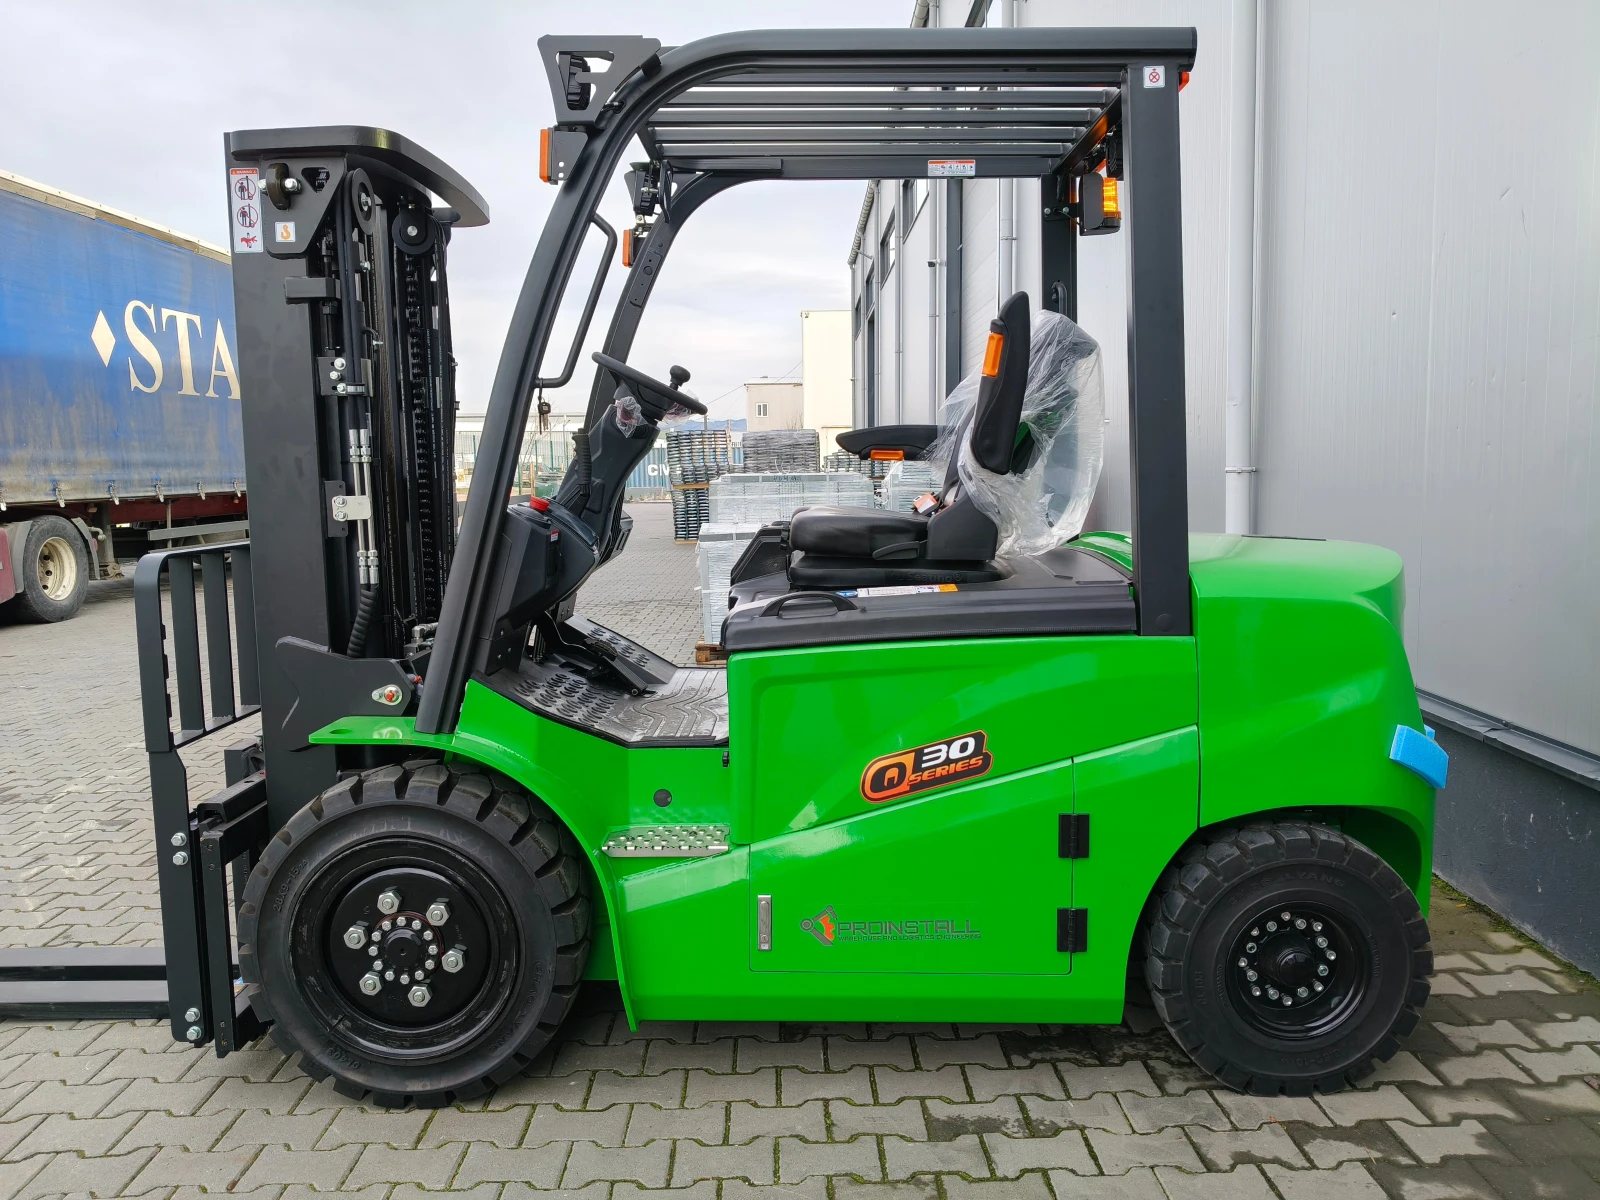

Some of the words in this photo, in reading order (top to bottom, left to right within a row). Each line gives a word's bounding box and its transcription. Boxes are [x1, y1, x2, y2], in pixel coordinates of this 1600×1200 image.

[124, 299, 241, 400] STA
[921, 737, 975, 768] 30
[907, 756, 983, 785] SERIES
[837, 919, 981, 935] PROINSTALL
